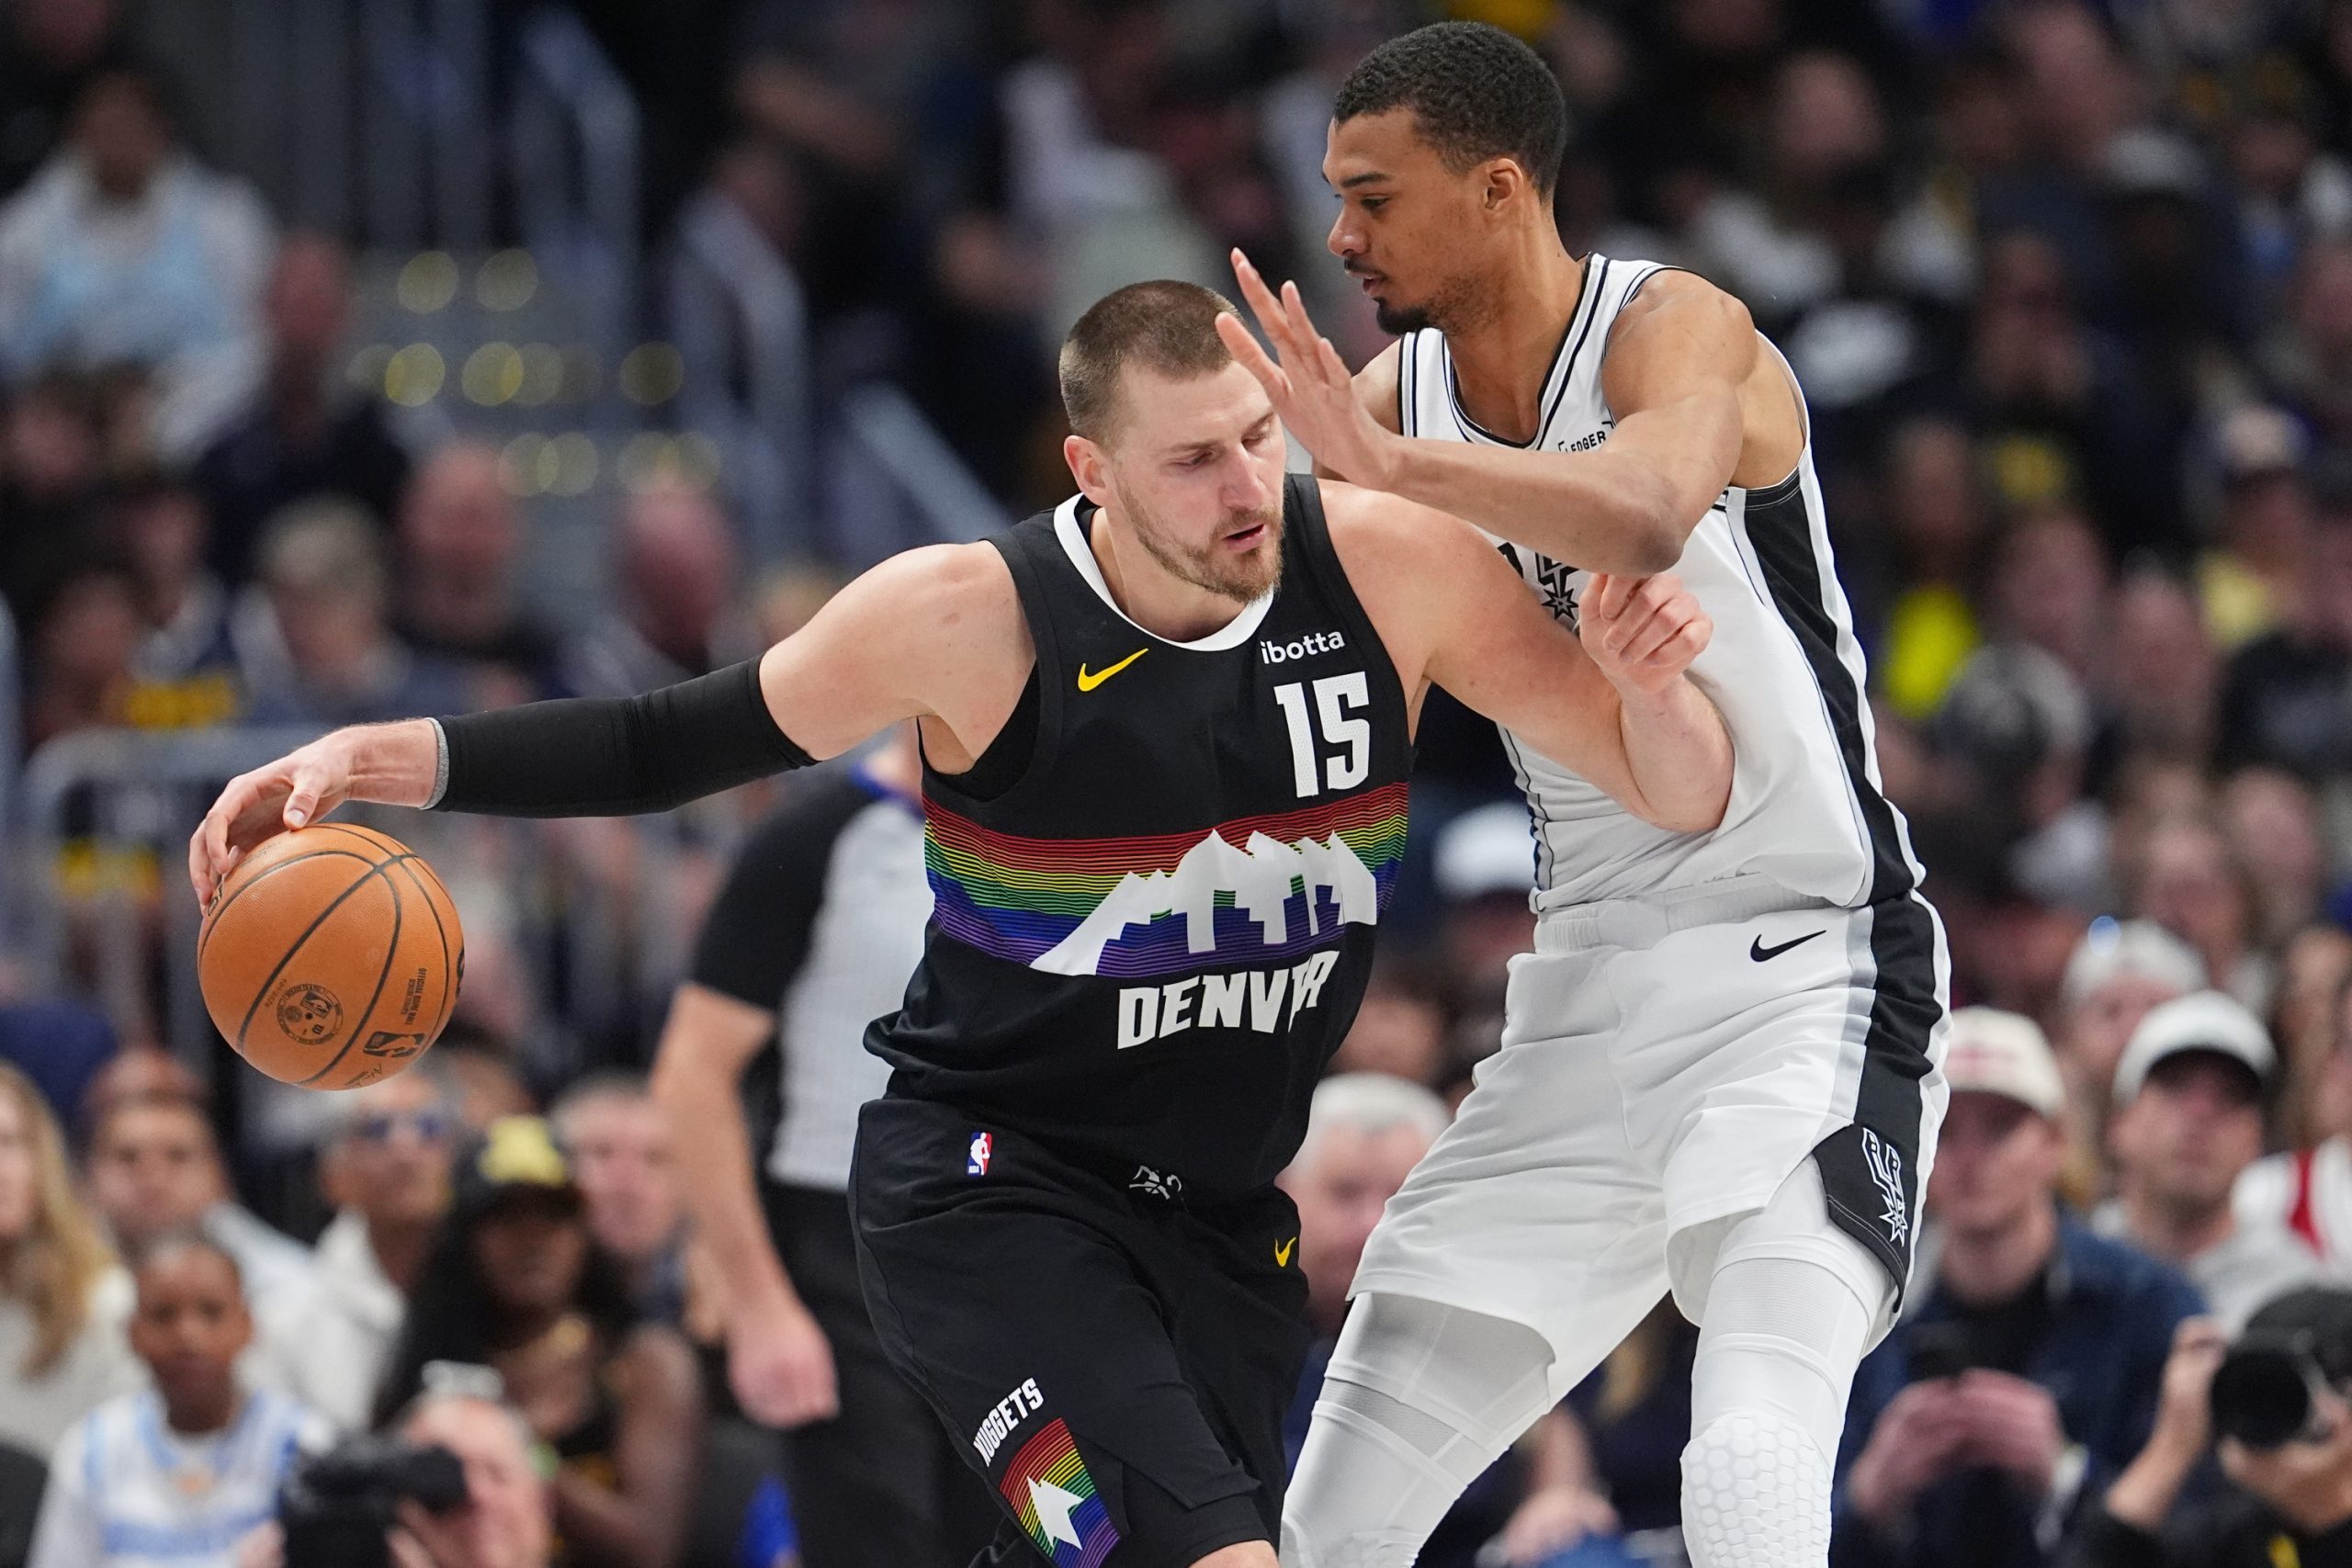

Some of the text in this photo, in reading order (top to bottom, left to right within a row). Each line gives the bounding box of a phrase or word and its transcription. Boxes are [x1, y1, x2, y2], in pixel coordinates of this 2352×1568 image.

[1260, 630, 1345, 665] ibotta
[1273, 671, 1370, 798] 15
[973, 1377, 1044, 1468] NUGGETS
